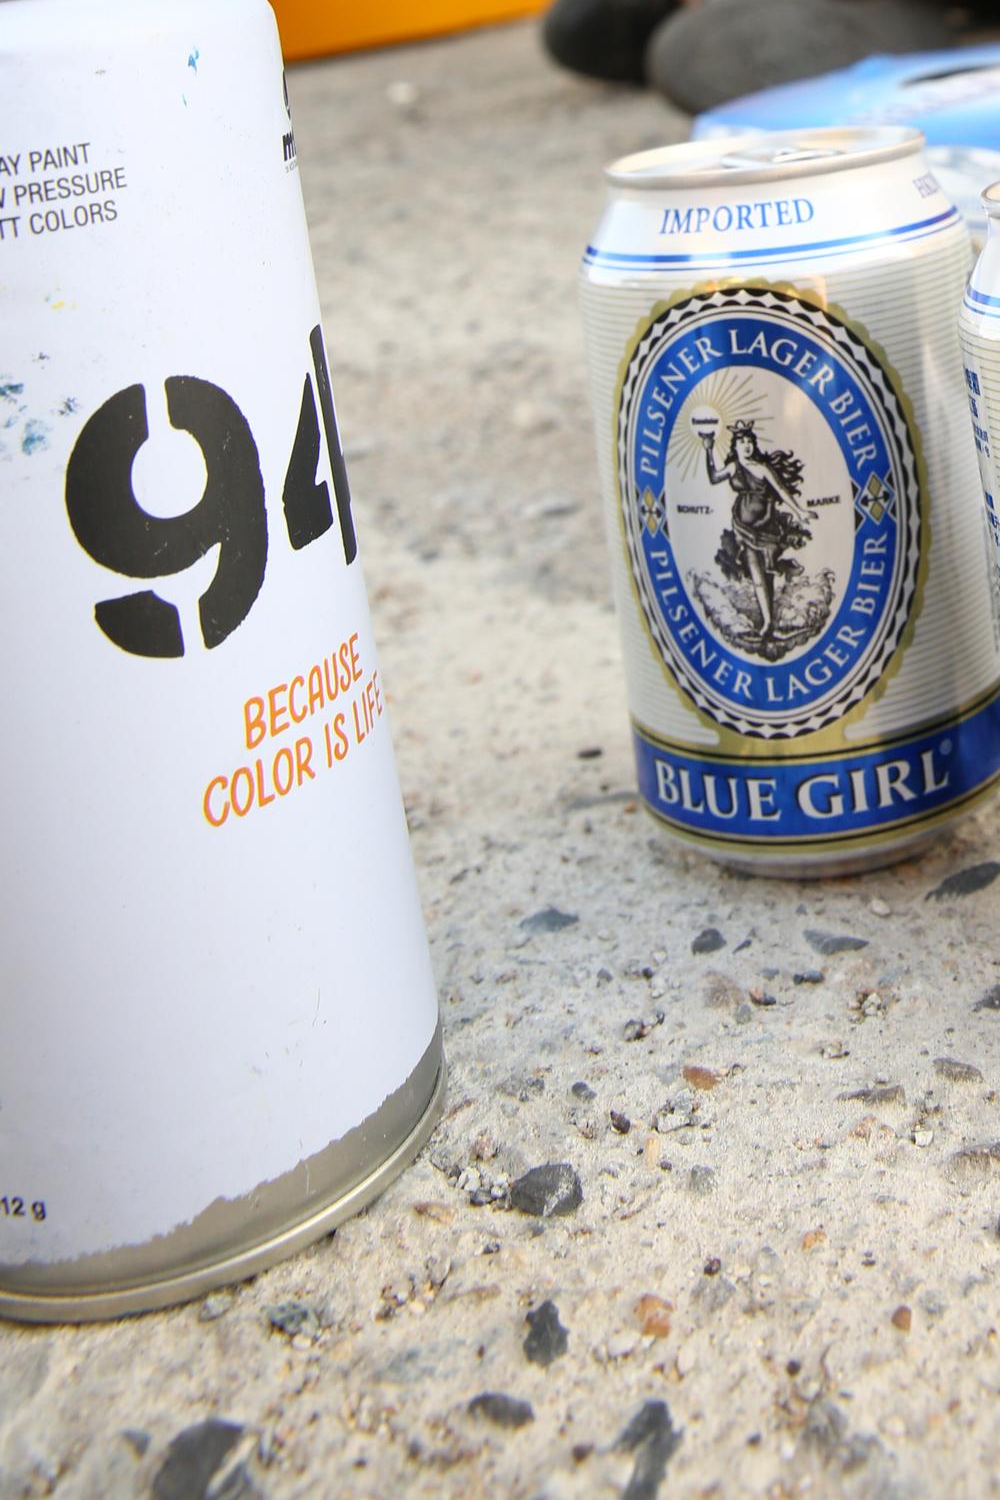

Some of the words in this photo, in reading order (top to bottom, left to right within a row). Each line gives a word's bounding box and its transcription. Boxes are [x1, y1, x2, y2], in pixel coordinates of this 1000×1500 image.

[29, 142, 91, 173] PAINT
[13, 167, 127, 206] PRESSURE
[29, 199, 118, 235] COLORS
[658, 197, 815, 236] IMPORTED
[640, 336, 724, 478] PILSENER
[728, 328, 834, 397] LAGER
[828, 389, 878, 472] BIER
[64, 324, 358, 659] 94
[806, 494, 841, 508] MARKE
[650, 549, 753, 700] PILSENER
[765, 624, 868, 703] LAGER
[850, 531, 889, 617] BIER
[243, 631, 364, 750] BECAUSE
[202, 736, 316, 828] COLOR
[325, 712, 349, 769] IS
[355, 670, 384, 744] LIFE
[653, 758, 782, 822] BLUE
[796, 749, 951, 815] GIRL
[31, 1201, 47, 1222] g
